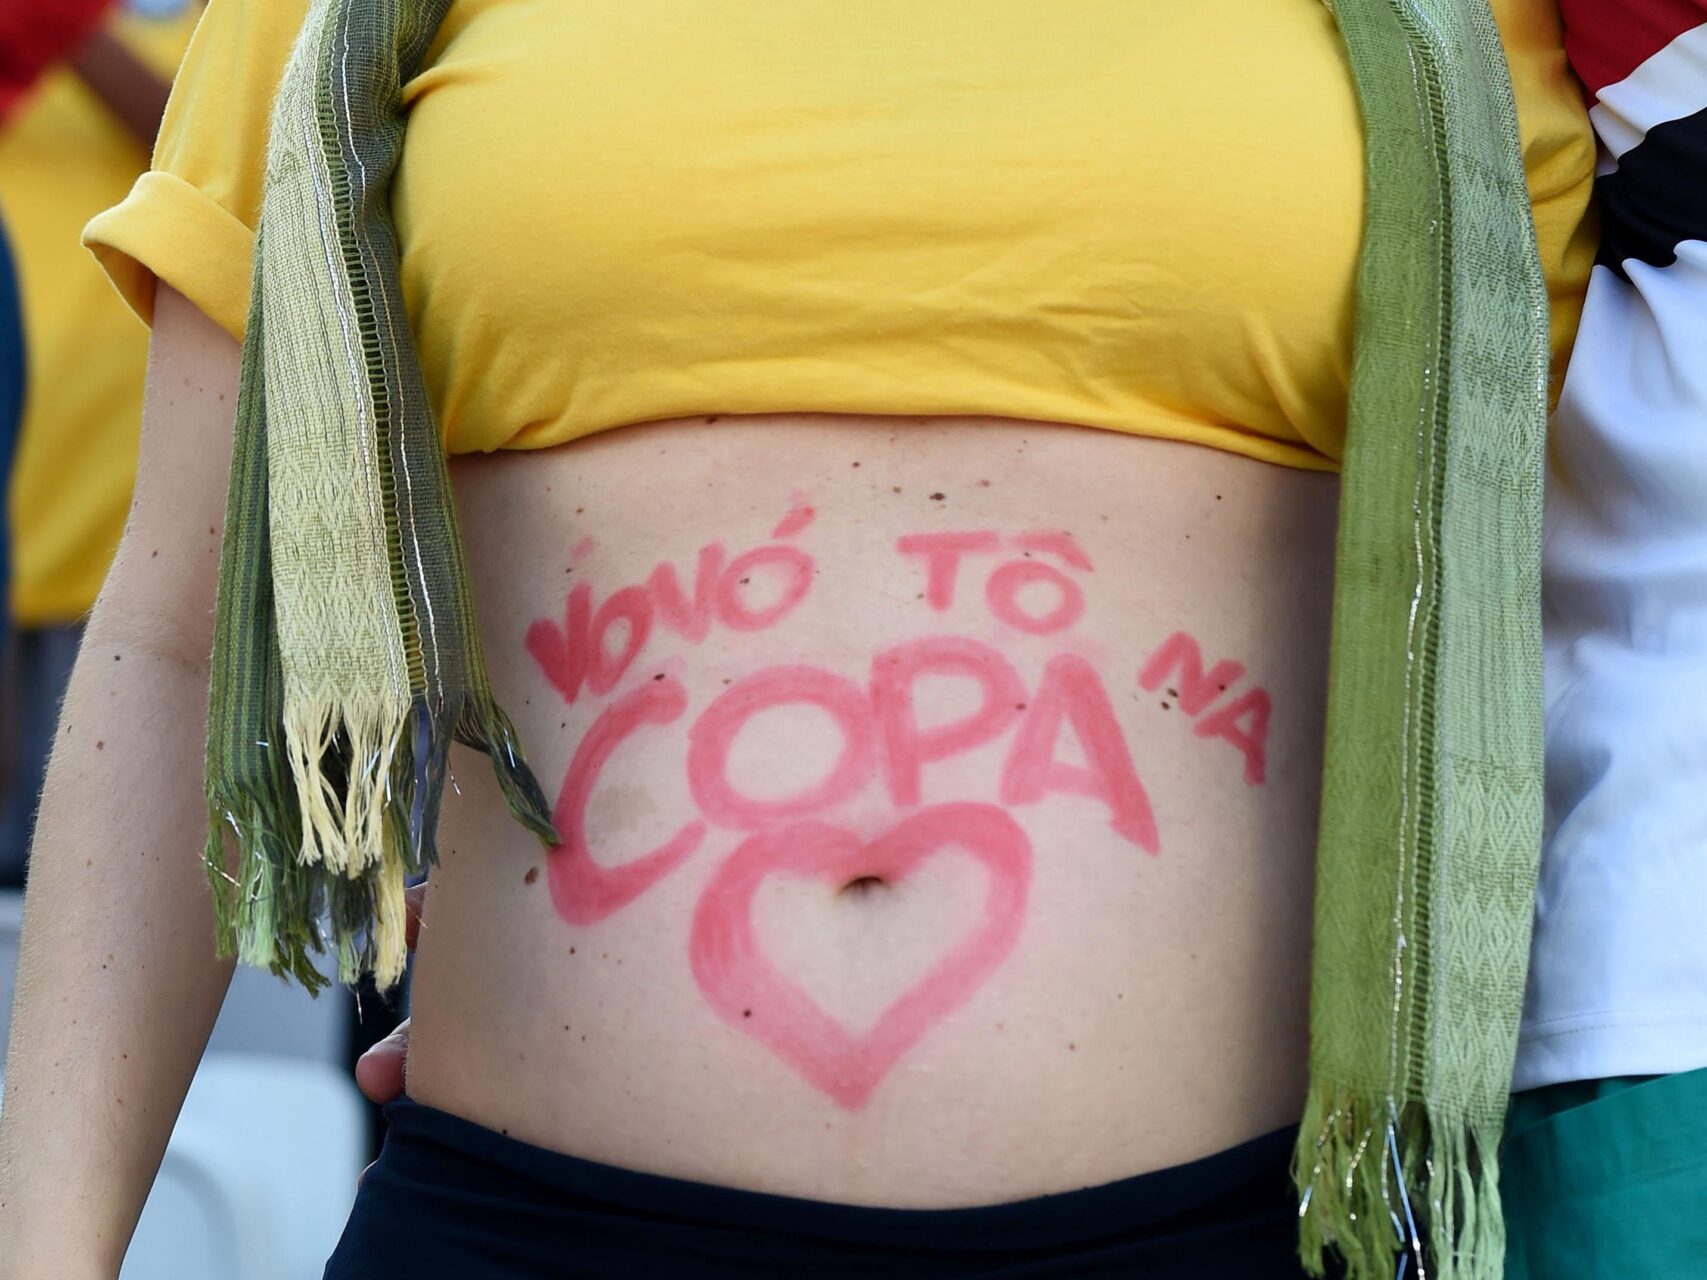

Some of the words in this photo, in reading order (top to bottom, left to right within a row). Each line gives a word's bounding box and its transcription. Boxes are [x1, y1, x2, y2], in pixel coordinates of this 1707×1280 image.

[546, 635, 1160, 926] COPA
[897, 530, 1094, 634] TÔ
[1138, 631, 1272, 786] NA
